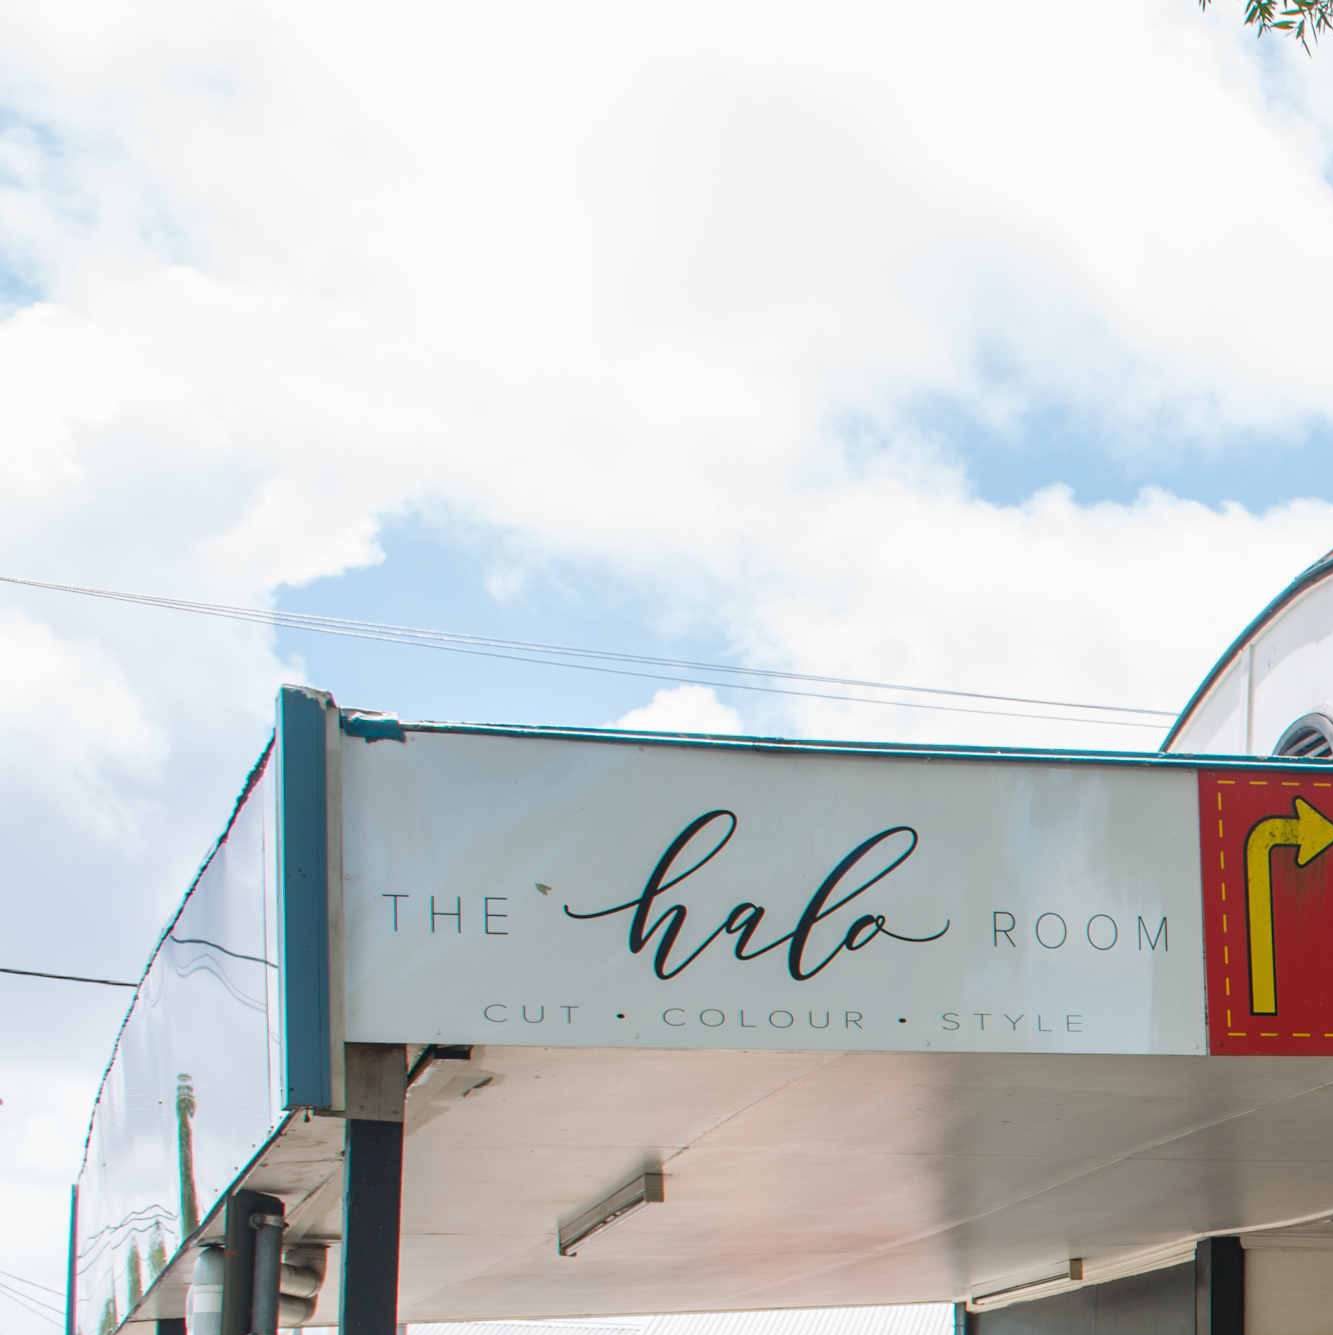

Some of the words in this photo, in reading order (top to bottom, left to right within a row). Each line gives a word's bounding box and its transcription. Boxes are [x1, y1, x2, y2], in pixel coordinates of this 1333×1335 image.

[382, 893, 510, 938] THE
[563, 809, 951, 981] halo
[992, 911, 1171, 954] ROOM
[482, 1002, 581, 1026] CUT
[662, 1006, 867, 1032] COLOUR
[940, 1011, 1086, 1035] STYLE
